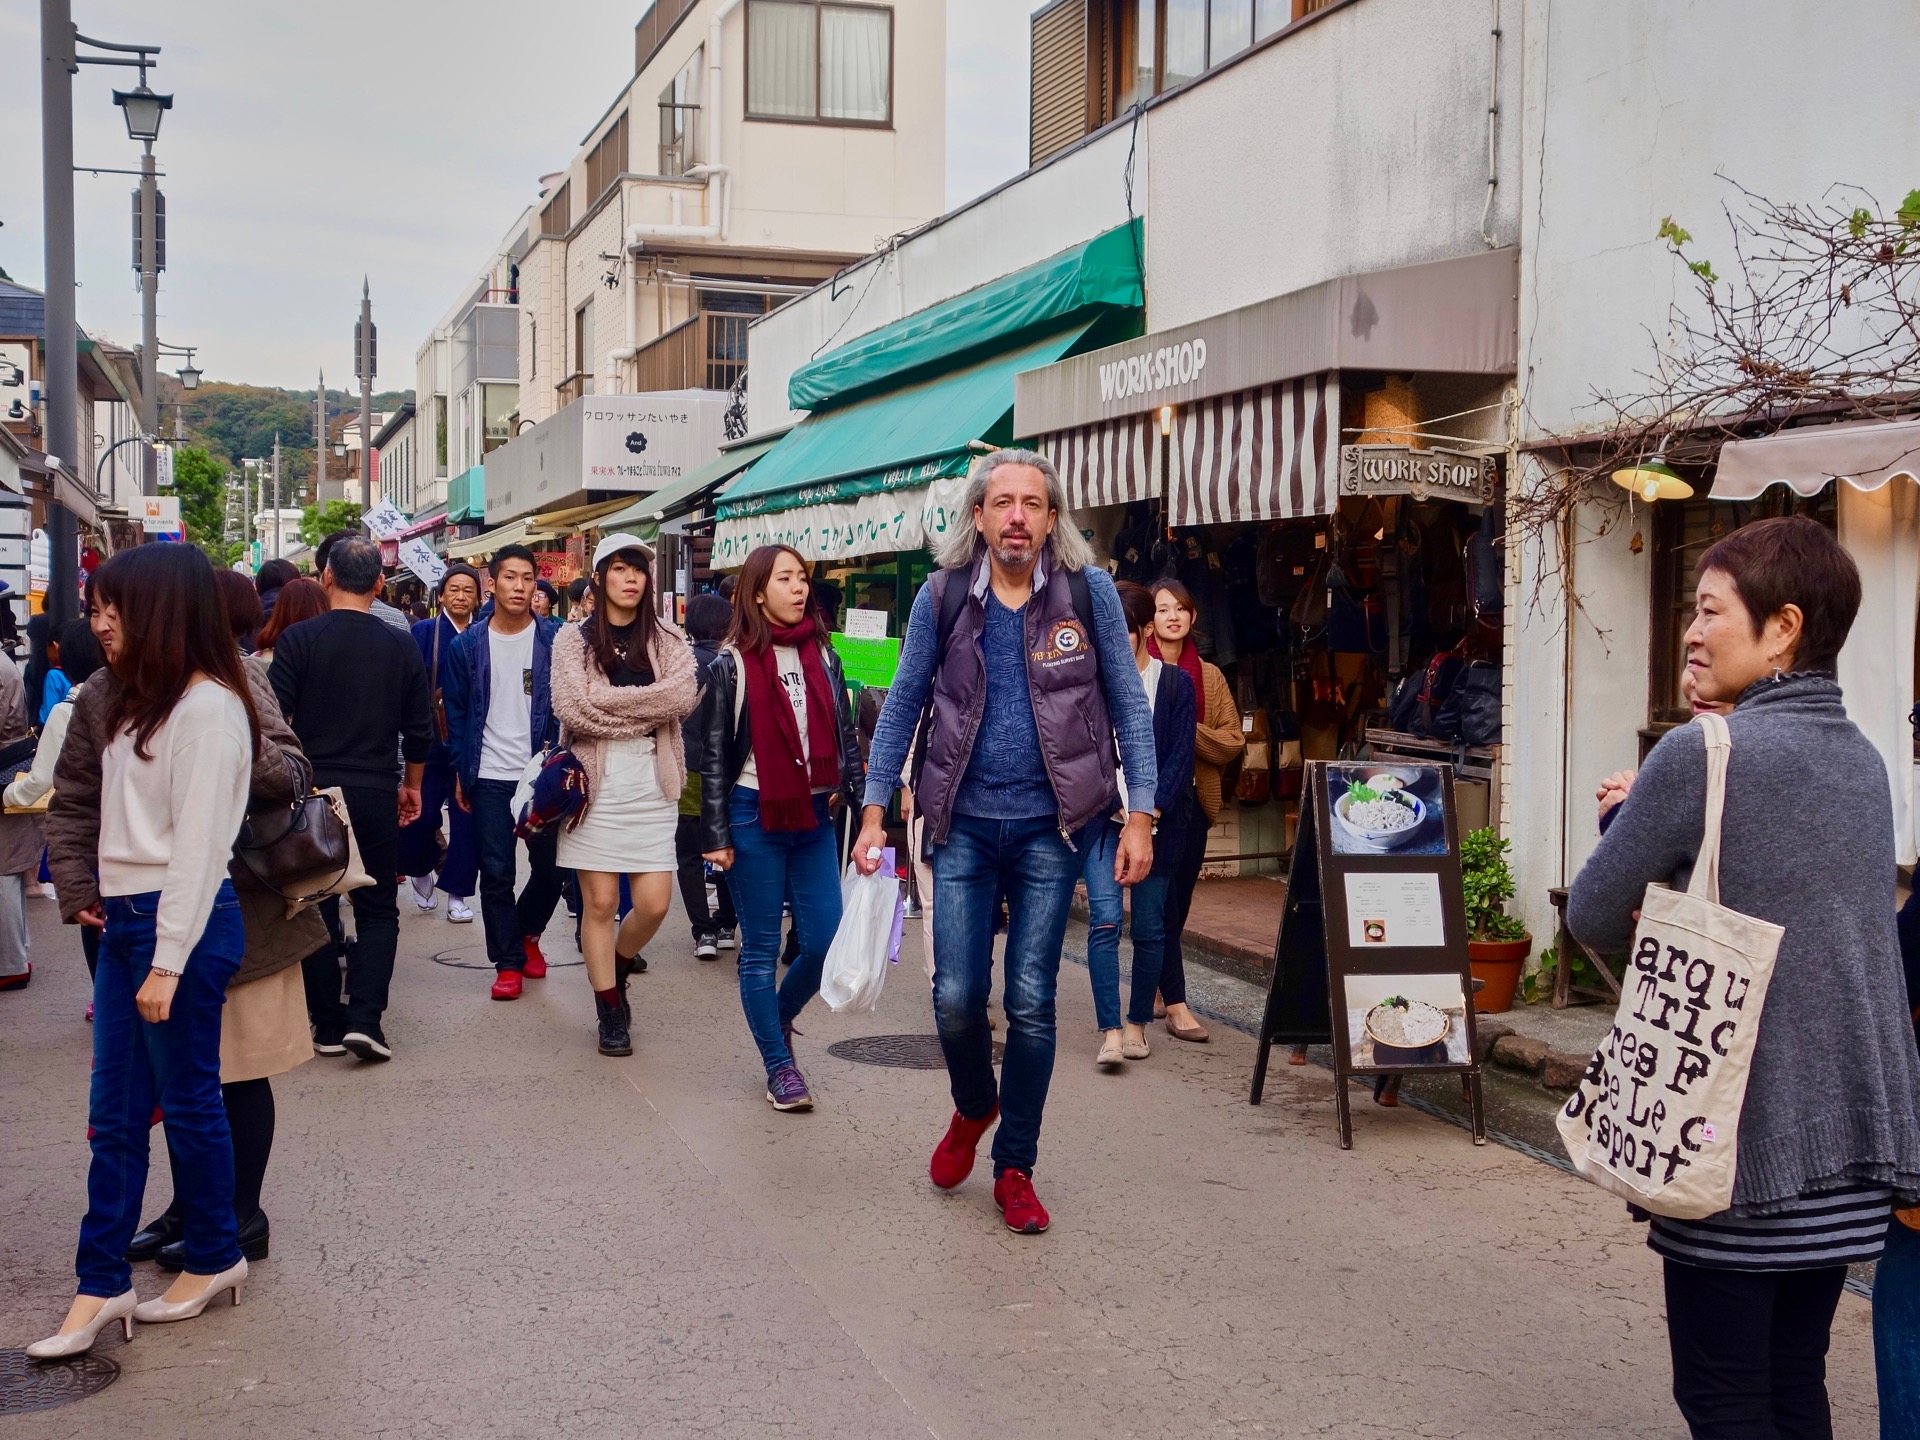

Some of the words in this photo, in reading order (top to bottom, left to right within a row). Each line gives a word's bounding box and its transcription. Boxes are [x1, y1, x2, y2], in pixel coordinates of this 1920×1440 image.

[584, 411, 688, 423] クロワッサンたいやき
[1363, 459, 1422, 482] WORK
[1042, 660, 1061, 668] FLOATING
[1060, 656, 1076, 665] SURVEY
